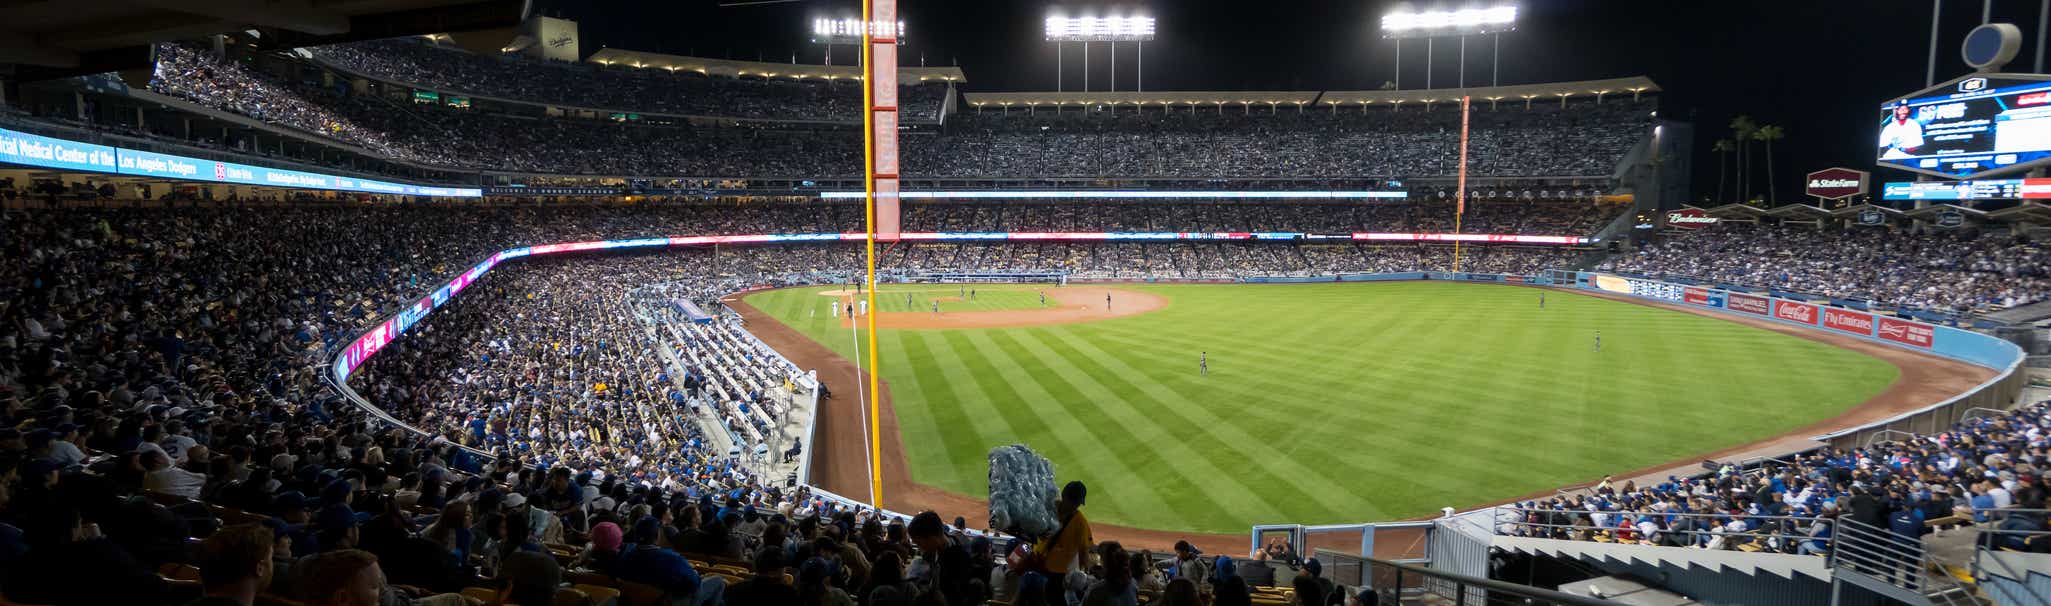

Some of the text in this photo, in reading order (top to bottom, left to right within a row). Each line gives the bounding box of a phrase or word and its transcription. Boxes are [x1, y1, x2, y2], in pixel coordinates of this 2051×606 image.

[19, 139, 53, 160] Medical
[54, 145, 87, 164] Center
[89, 150, 100, 165] of
[100, 151, 115, 167] the
[118, 153, 197, 176] Los Angeles Dodgers
[1668, 213, 1718, 223] Budweiser
[1824, 311, 1872, 330] Fly Emirates
